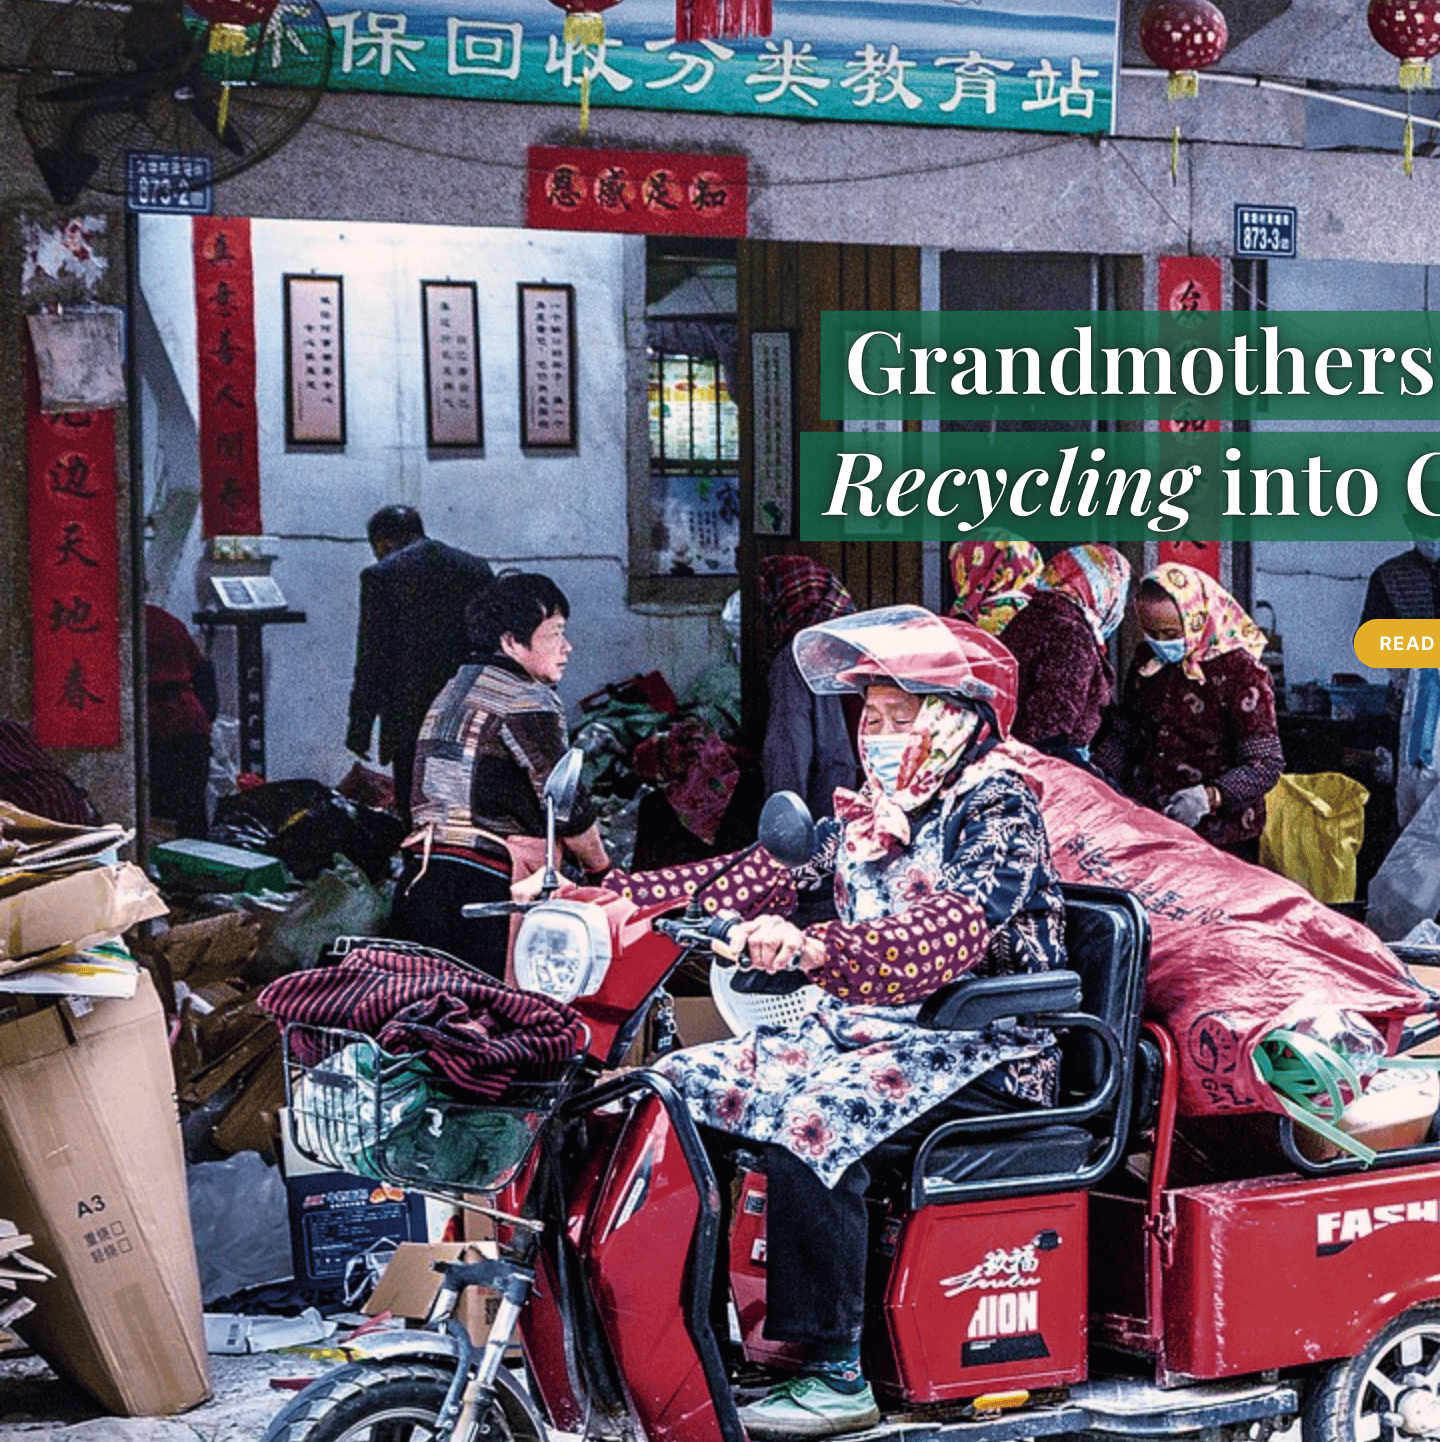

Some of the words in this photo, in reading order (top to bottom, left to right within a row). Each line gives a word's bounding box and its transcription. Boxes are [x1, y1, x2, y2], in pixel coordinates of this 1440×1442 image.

[50, 411, 104, 712] 边天地春
[78, 1195, 105, 1218] A3
